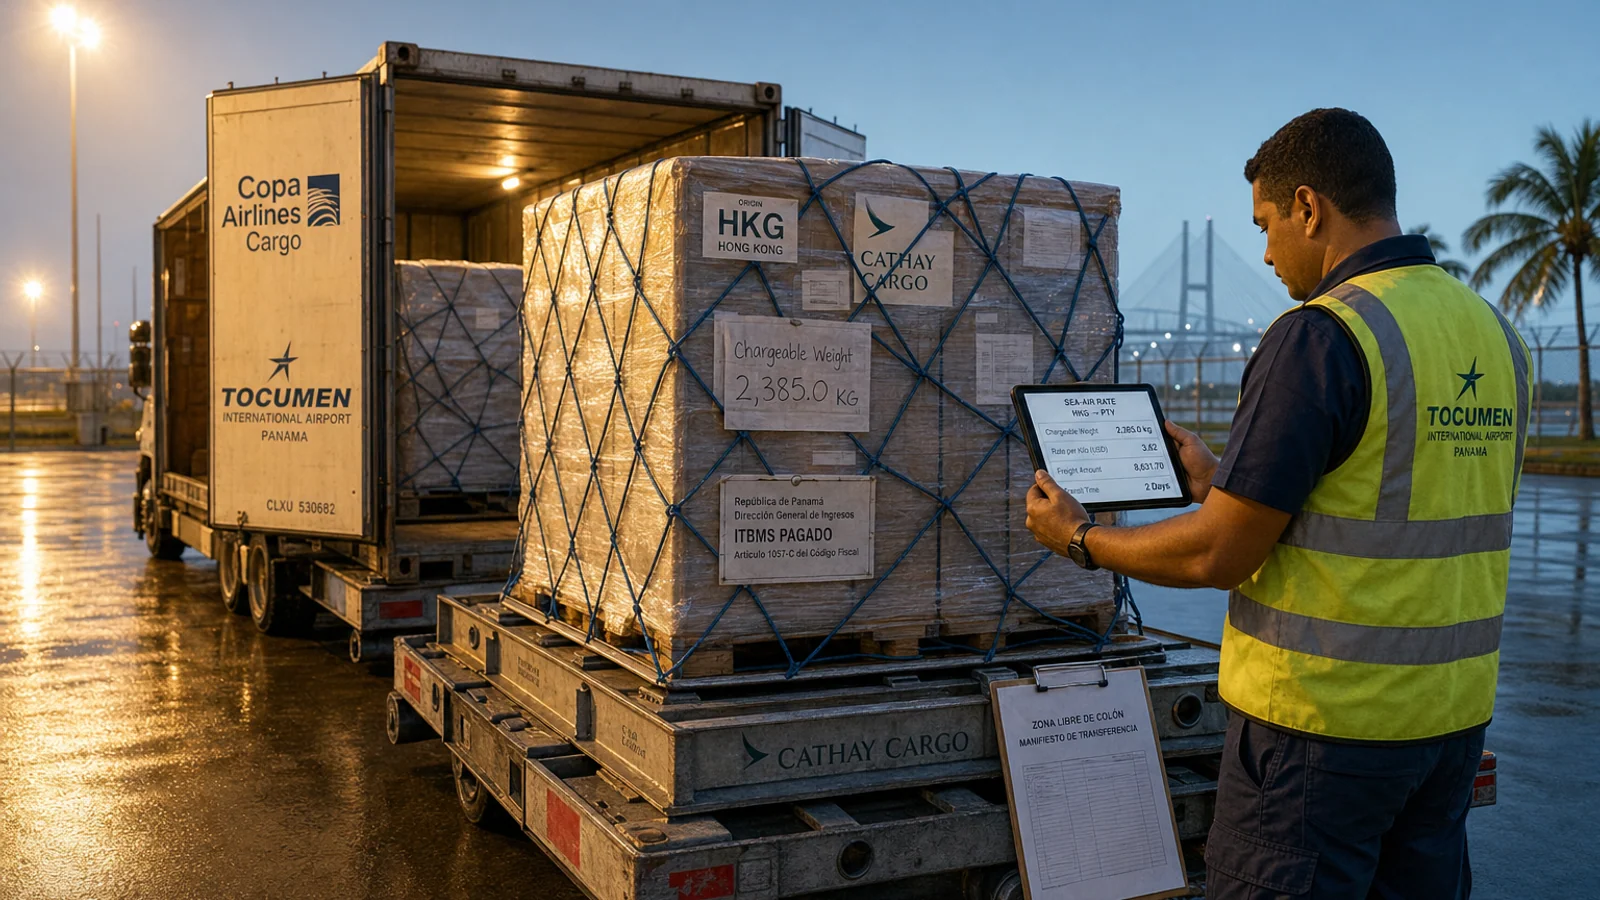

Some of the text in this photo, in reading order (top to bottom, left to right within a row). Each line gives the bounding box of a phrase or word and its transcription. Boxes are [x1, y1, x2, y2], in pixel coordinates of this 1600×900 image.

[238, 175, 300, 203] Copa
[739, 199, 762, 207] ORIGIN
[222, 204, 301, 228] Airlines
[718, 209, 784, 240] HKG
[246, 231, 301, 256] Cargo
[718, 241, 783, 254] HONG KONG
[861, 250, 935, 270] CATHAY
[862, 273, 928, 290] CARGO
[734, 340, 853, 370] Chargeable Weight
[222, 388, 352, 408] TOCUMEN
[736, 375, 859, 406] 2,385.0 KG
[223, 412, 352, 424] INTERNATIONAL AIRPORT
[1427, 406, 1512, 426] TOCUMEN
[261, 430, 308, 442] PANAMA
[1428, 431, 1513, 441] INTERNATIONAL AIRPORT
[1454, 447, 1487, 457] PANAMA
[1152, 482, 1170, 491] Days
[266, 499, 335, 515] CLXU 530682
[734, 496, 824, 507] República de Panamá
[735, 510, 854, 521] Dirección General de Ingresos
[735, 527, 832, 543] ITBMS PAGADO
[768, 549, 794, 558] 1057-C
[796, 549, 808, 557] del
[810, 548, 835, 558] Código
[838, 548, 859, 556] Fiscal
[1032, 708, 1124, 730] ZONA LIBRE DE COLÓN
[1019, 724, 1138, 747] MANIFIESTO DE TRANSFERENCIA
[778, 732, 969, 769] CATHAY CARGO
